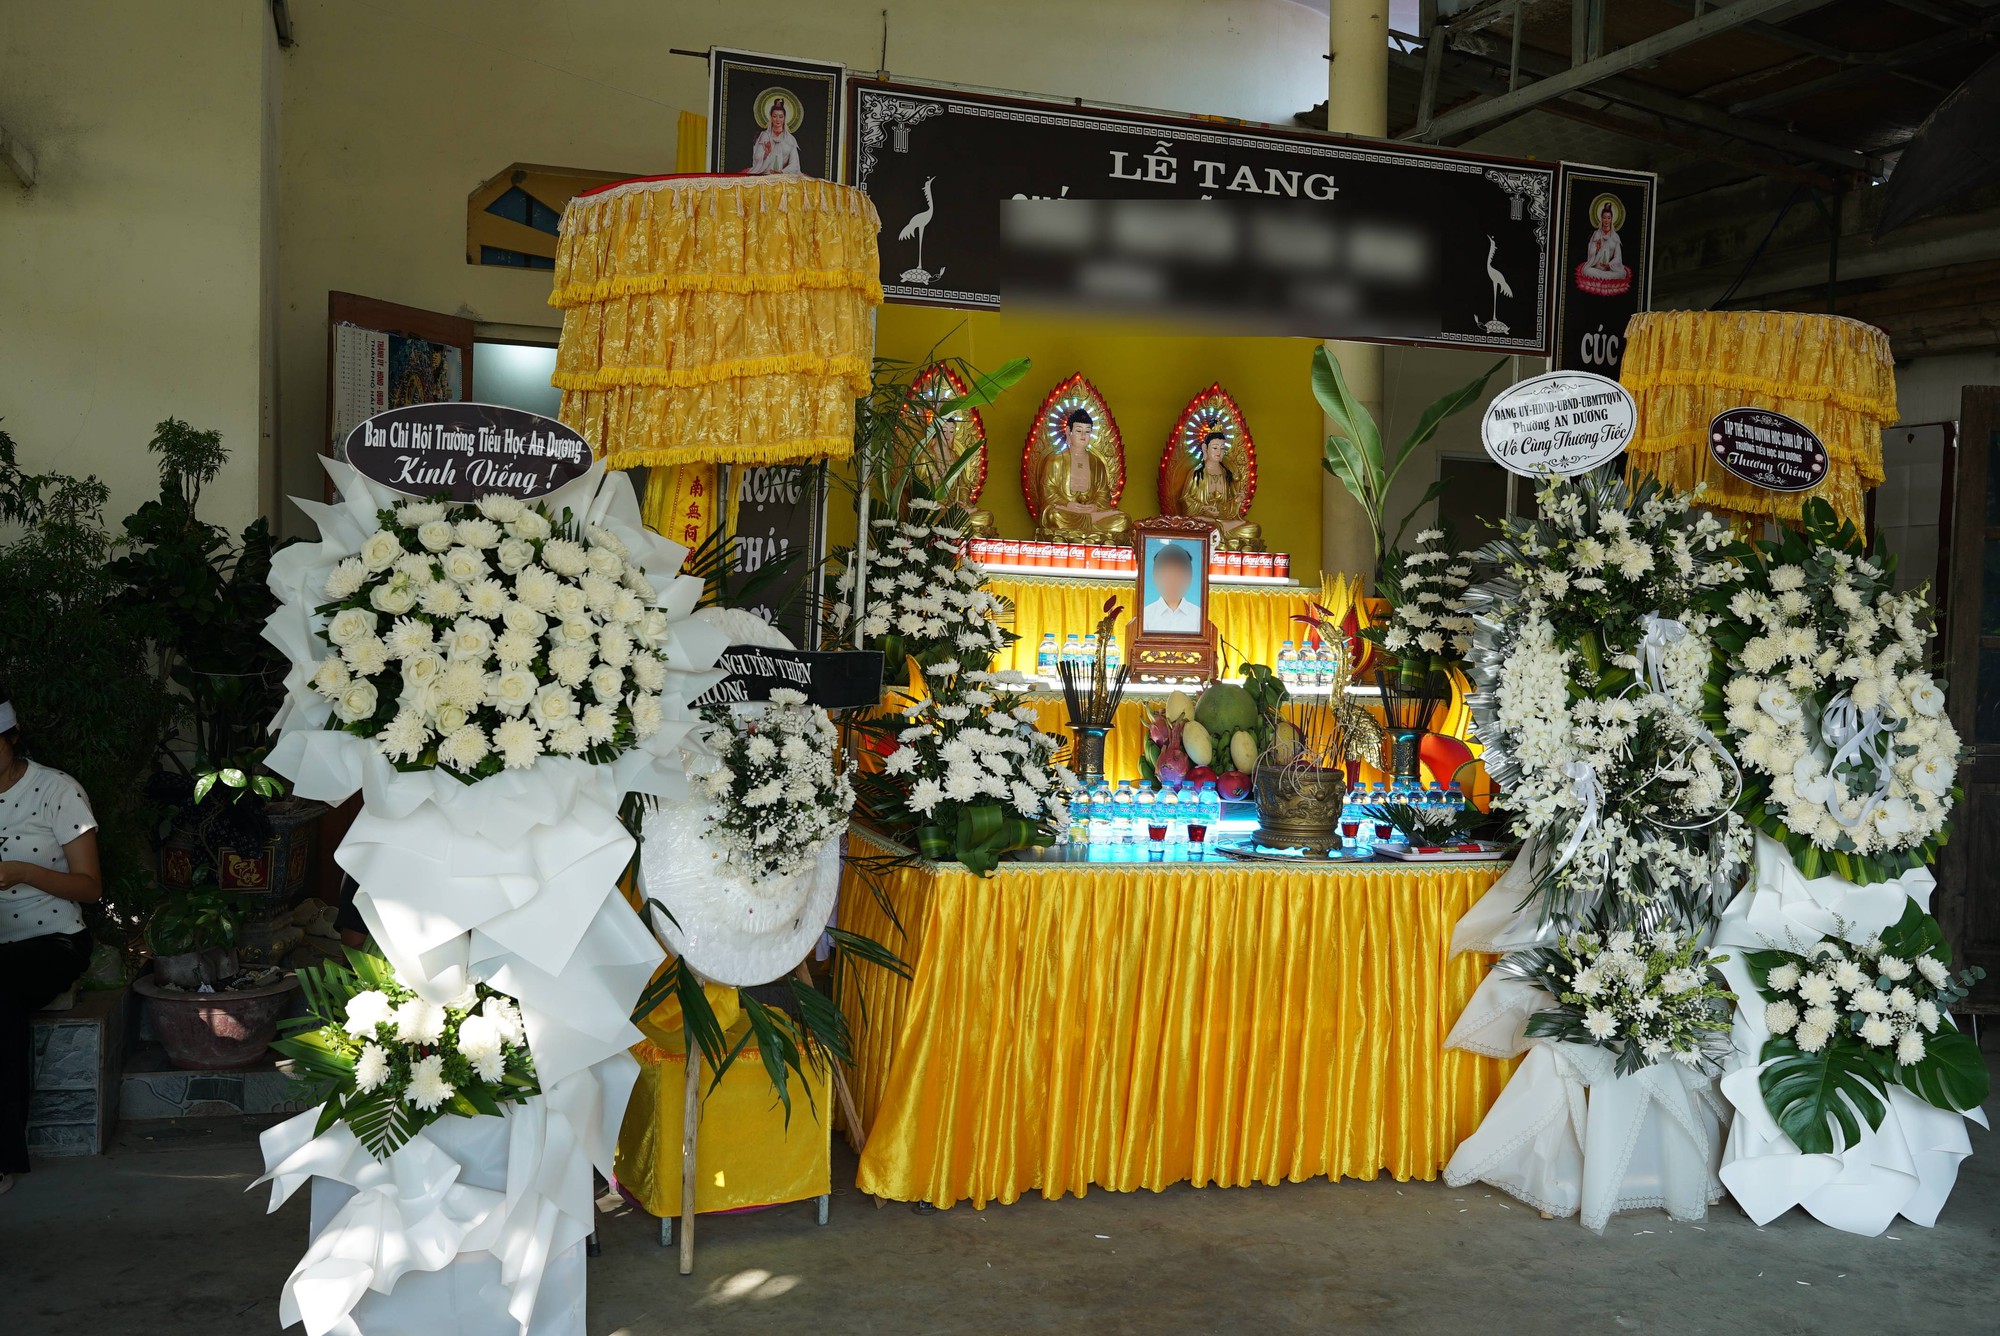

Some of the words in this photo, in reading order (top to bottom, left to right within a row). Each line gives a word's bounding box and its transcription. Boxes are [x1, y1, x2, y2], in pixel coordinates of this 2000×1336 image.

[1108, 140, 1177, 184] LỄ
[1193, 160, 1340, 201] TANG
[1580, 324, 1620, 367] CÚC
[364, 421, 386, 447] Ban
[390, 421, 409, 449] Chi
[412, 422, 432, 456] Hội
[434, 424, 476, 457] Trường
[477, 425, 501, 453] Tiểu
[504, 429, 526, 461] Học
[528, 430, 545, 456] An
[1497, 439, 1519, 457] Vô
[1521, 436, 1552, 456] Cùng
[1553, 430, 1600, 450] Thương
[1600, 423, 1627, 443] Tiếc
[1512, 419, 1550, 434] Phường
[1554, 414, 1569, 428] AN
[1573, 409, 1609, 425] DƯƠNG
[1728, 451, 1774, 473] Thương
[1777, 462, 1812, 482] Viếng
[1777, 450, 1785, 460] AN
[388, 455, 457, 486] Kính
[465, 457, 539, 495] Viếng
[546, 463, 558, 490] !
[719, 649, 778, 677] NGUYỄN
[775, 657, 812, 688] THIỆN
